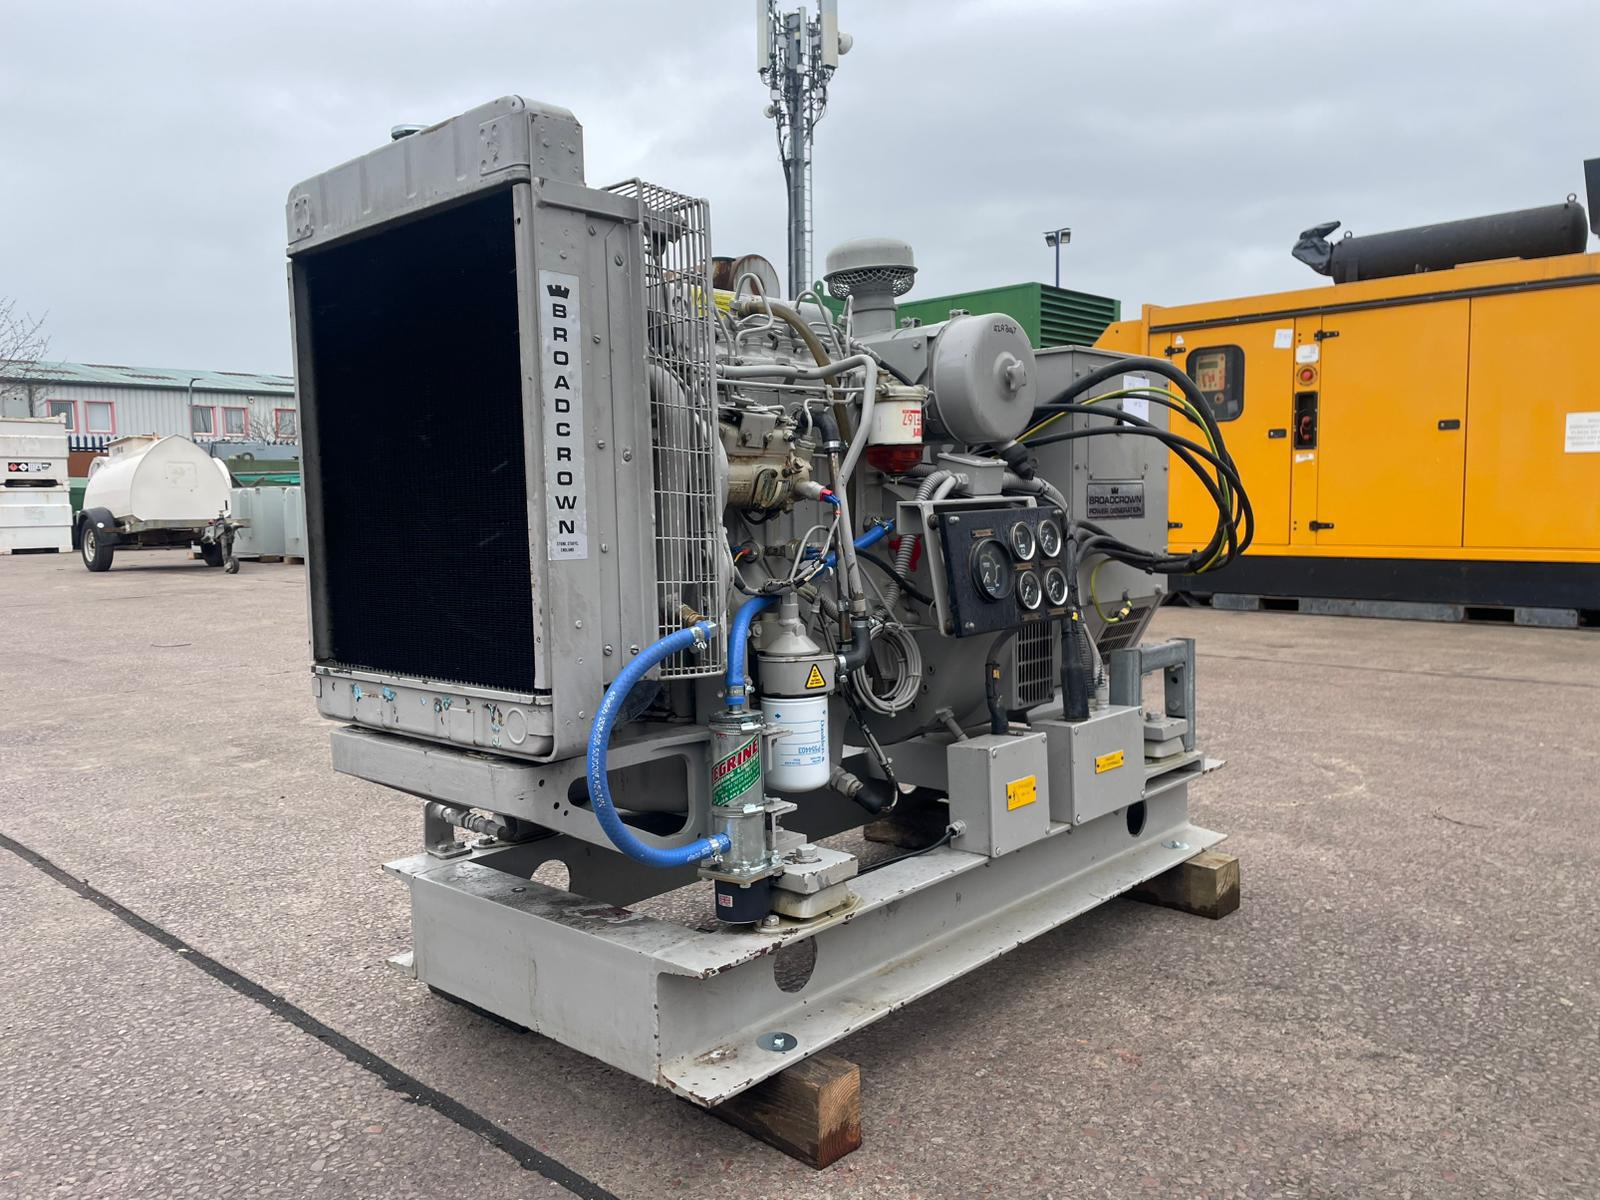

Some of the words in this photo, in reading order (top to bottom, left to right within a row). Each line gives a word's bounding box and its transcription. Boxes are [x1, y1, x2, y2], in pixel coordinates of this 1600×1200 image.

[552, 303, 577, 534] BROADCROWN
[1088, 495, 1141, 505] BROADCROWN
[1110, 506, 1141, 514] GENERATION
